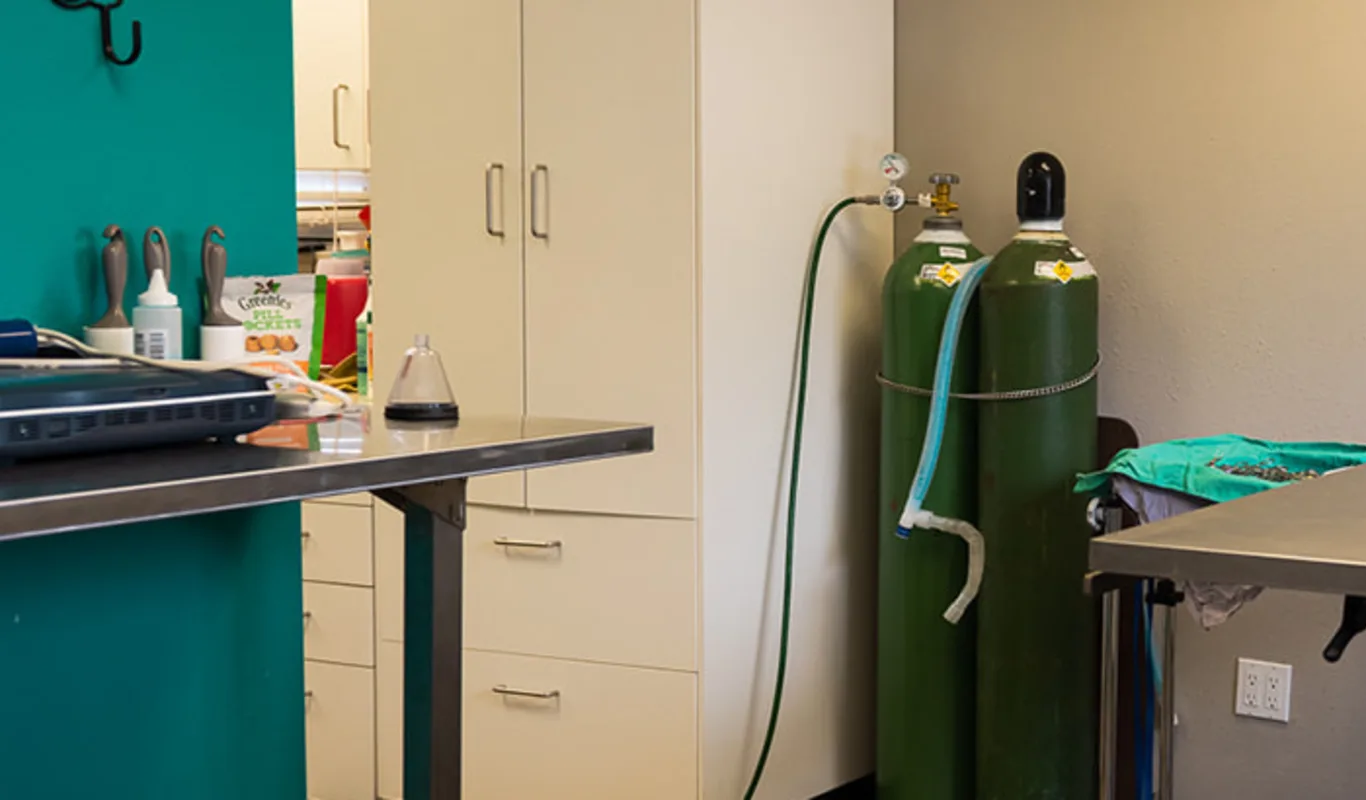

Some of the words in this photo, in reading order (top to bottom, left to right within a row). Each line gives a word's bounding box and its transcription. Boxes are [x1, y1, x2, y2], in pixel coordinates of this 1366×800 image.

[238, 294, 292, 311] Greenies
[253, 309, 283, 320] PILL
[243, 318, 302, 331] OCKETS
